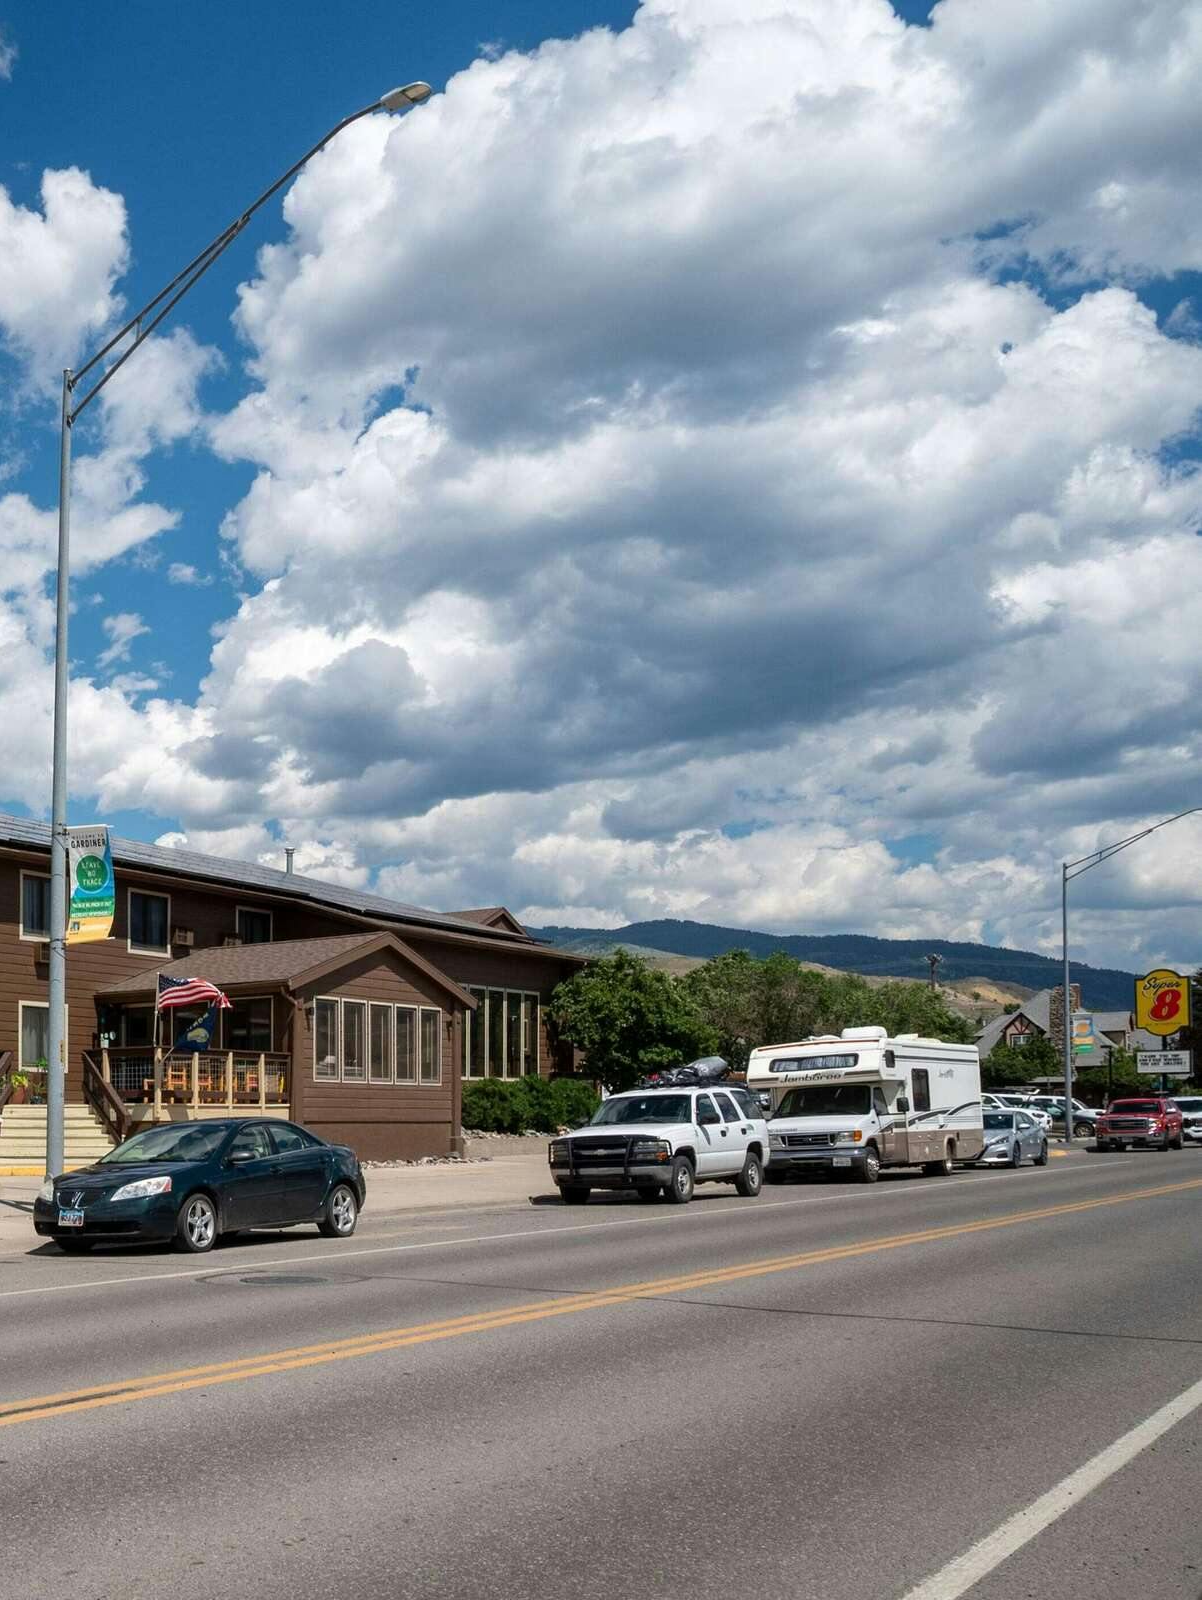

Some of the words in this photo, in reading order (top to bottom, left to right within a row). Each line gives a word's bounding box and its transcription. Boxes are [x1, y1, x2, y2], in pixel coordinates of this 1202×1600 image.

[70, 838, 106, 849] GARDINER
[81, 861, 102, 869] LEAVE
[87, 870, 96, 878] NO
[82, 878, 103, 886] TRACE
[1142, 976, 1182, 996] Super
[1149, 988, 1182, 1021] 8
